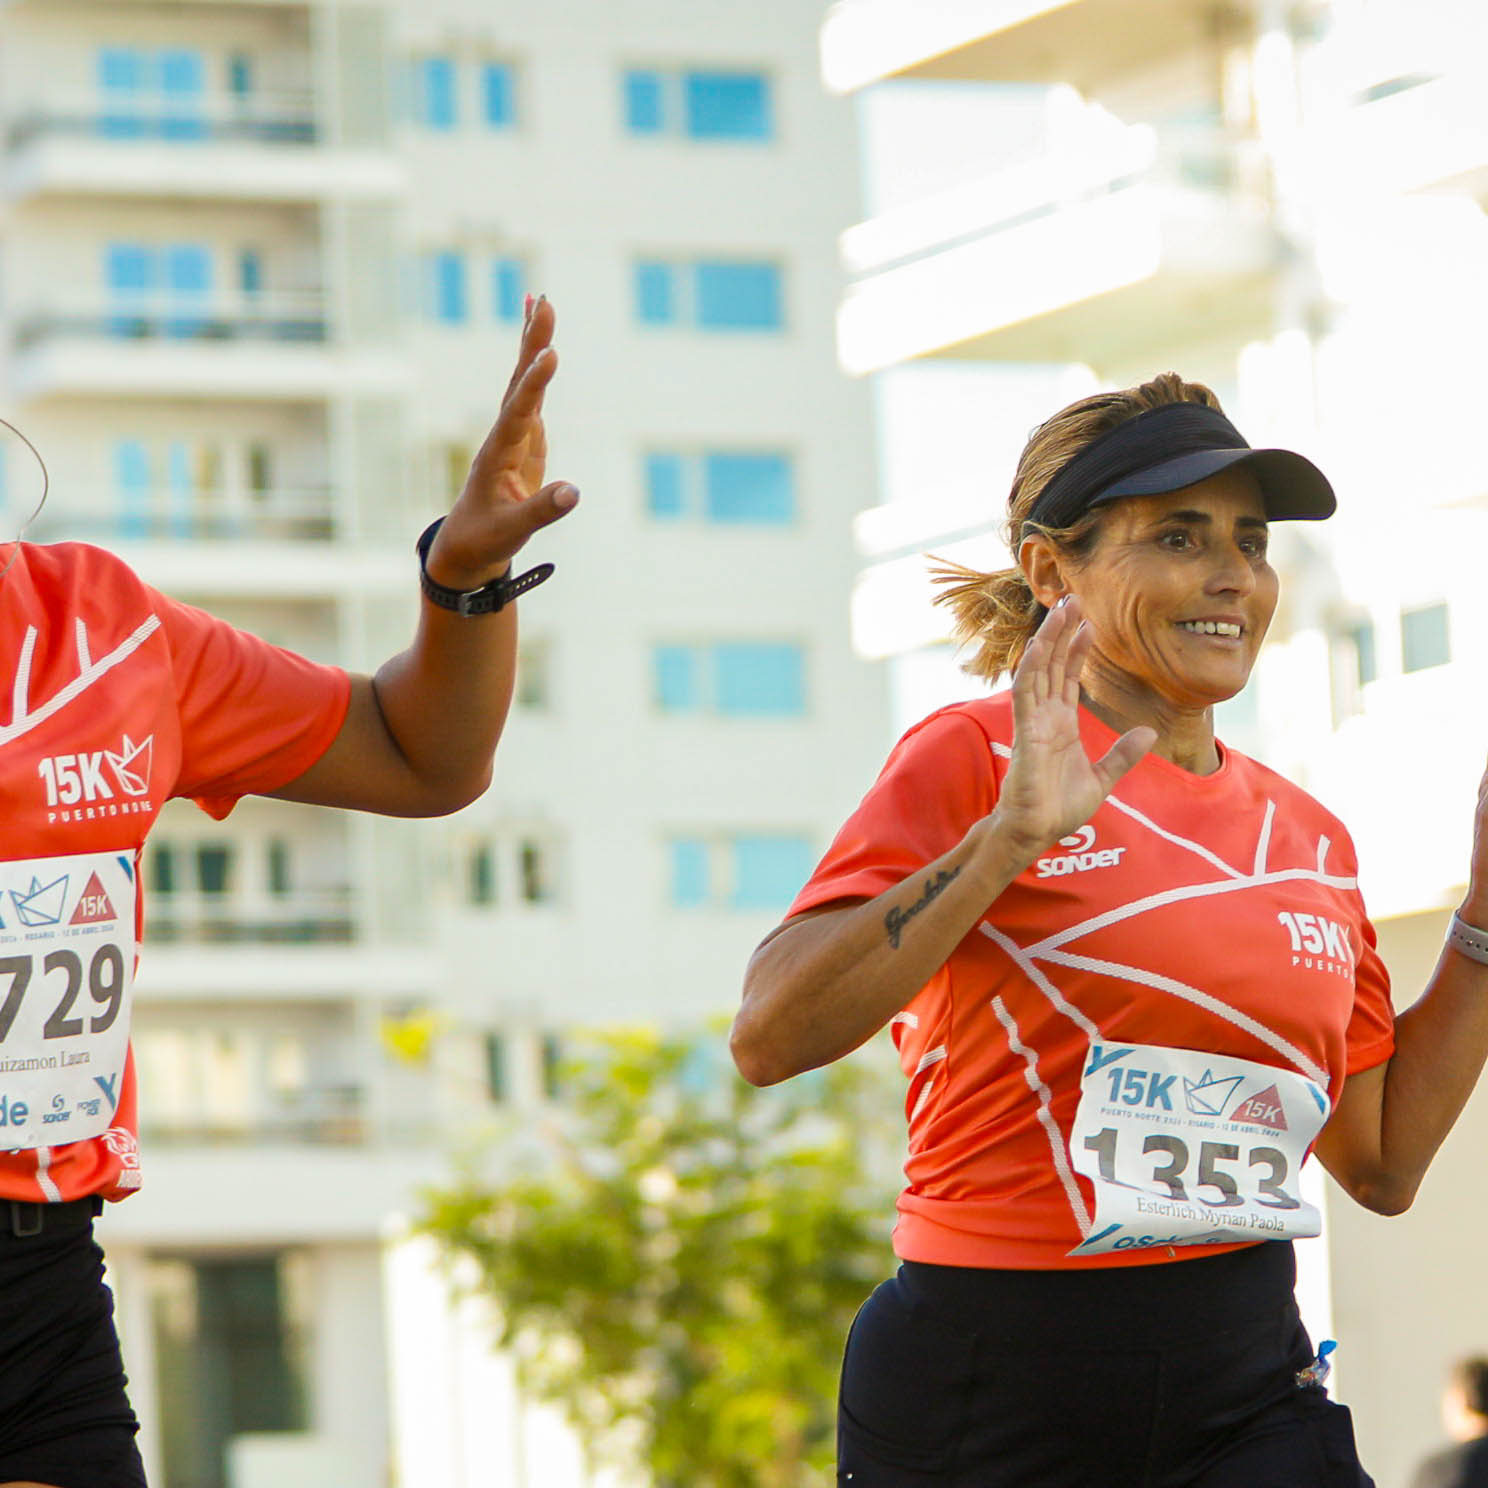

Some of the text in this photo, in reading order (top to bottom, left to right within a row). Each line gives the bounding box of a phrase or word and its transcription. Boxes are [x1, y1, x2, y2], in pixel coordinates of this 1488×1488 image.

[37, 751, 114, 806] 15K
[79, 891, 109, 917] 15K
[1277, 911, 1347, 963] 15K
[60, 1050, 91, 1068] Laura
[1107, 1067, 1179, 1111] 15K
[1243, 1099, 1280, 1124] 15K
[1083, 1127, 1300, 1210] 1353
[1250, 1213, 1285, 1232] Paola
